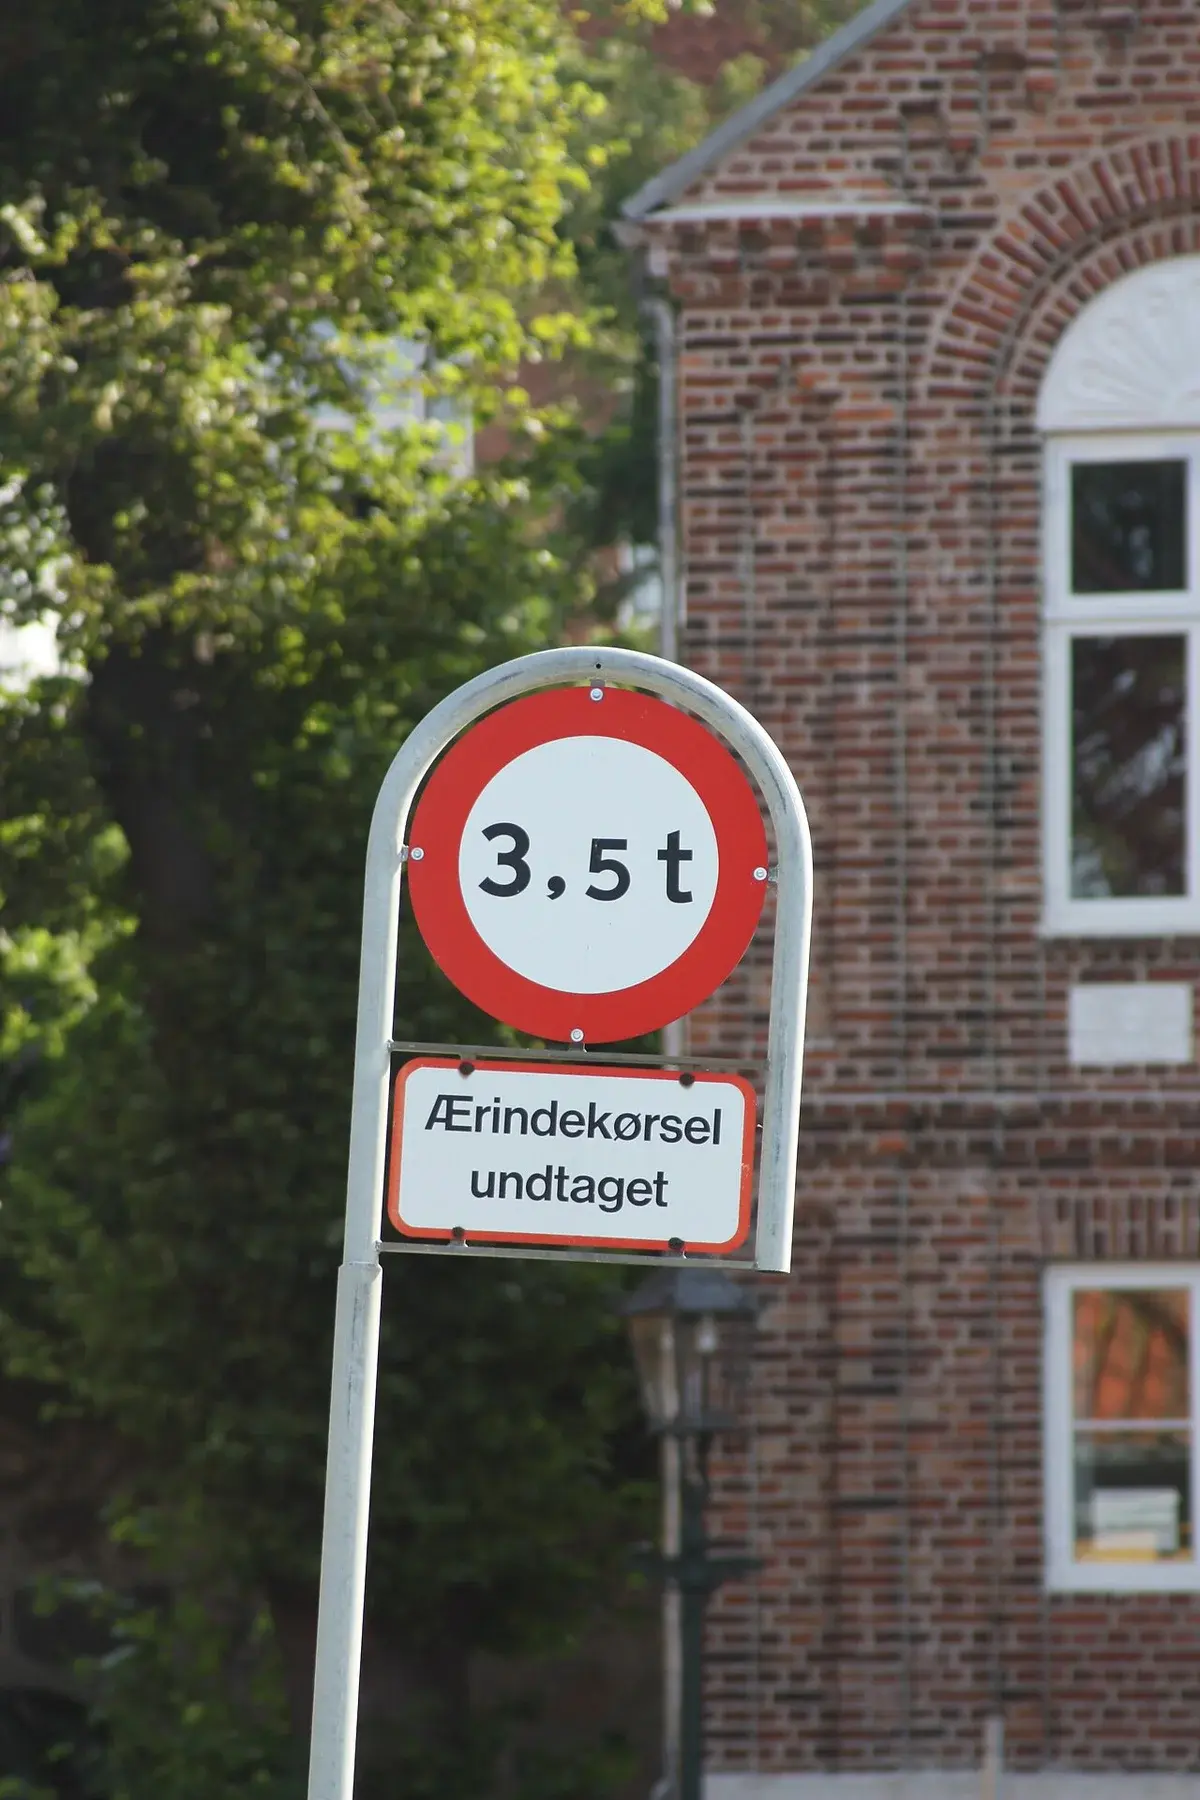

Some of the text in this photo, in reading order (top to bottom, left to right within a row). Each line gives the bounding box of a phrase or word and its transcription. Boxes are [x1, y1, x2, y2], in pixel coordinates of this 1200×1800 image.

[478, 822, 693, 903] 3,5 t
[424, 1094, 722, 1145] Ærindekørsel
[470, 1164, 669, 1213] undtaget
